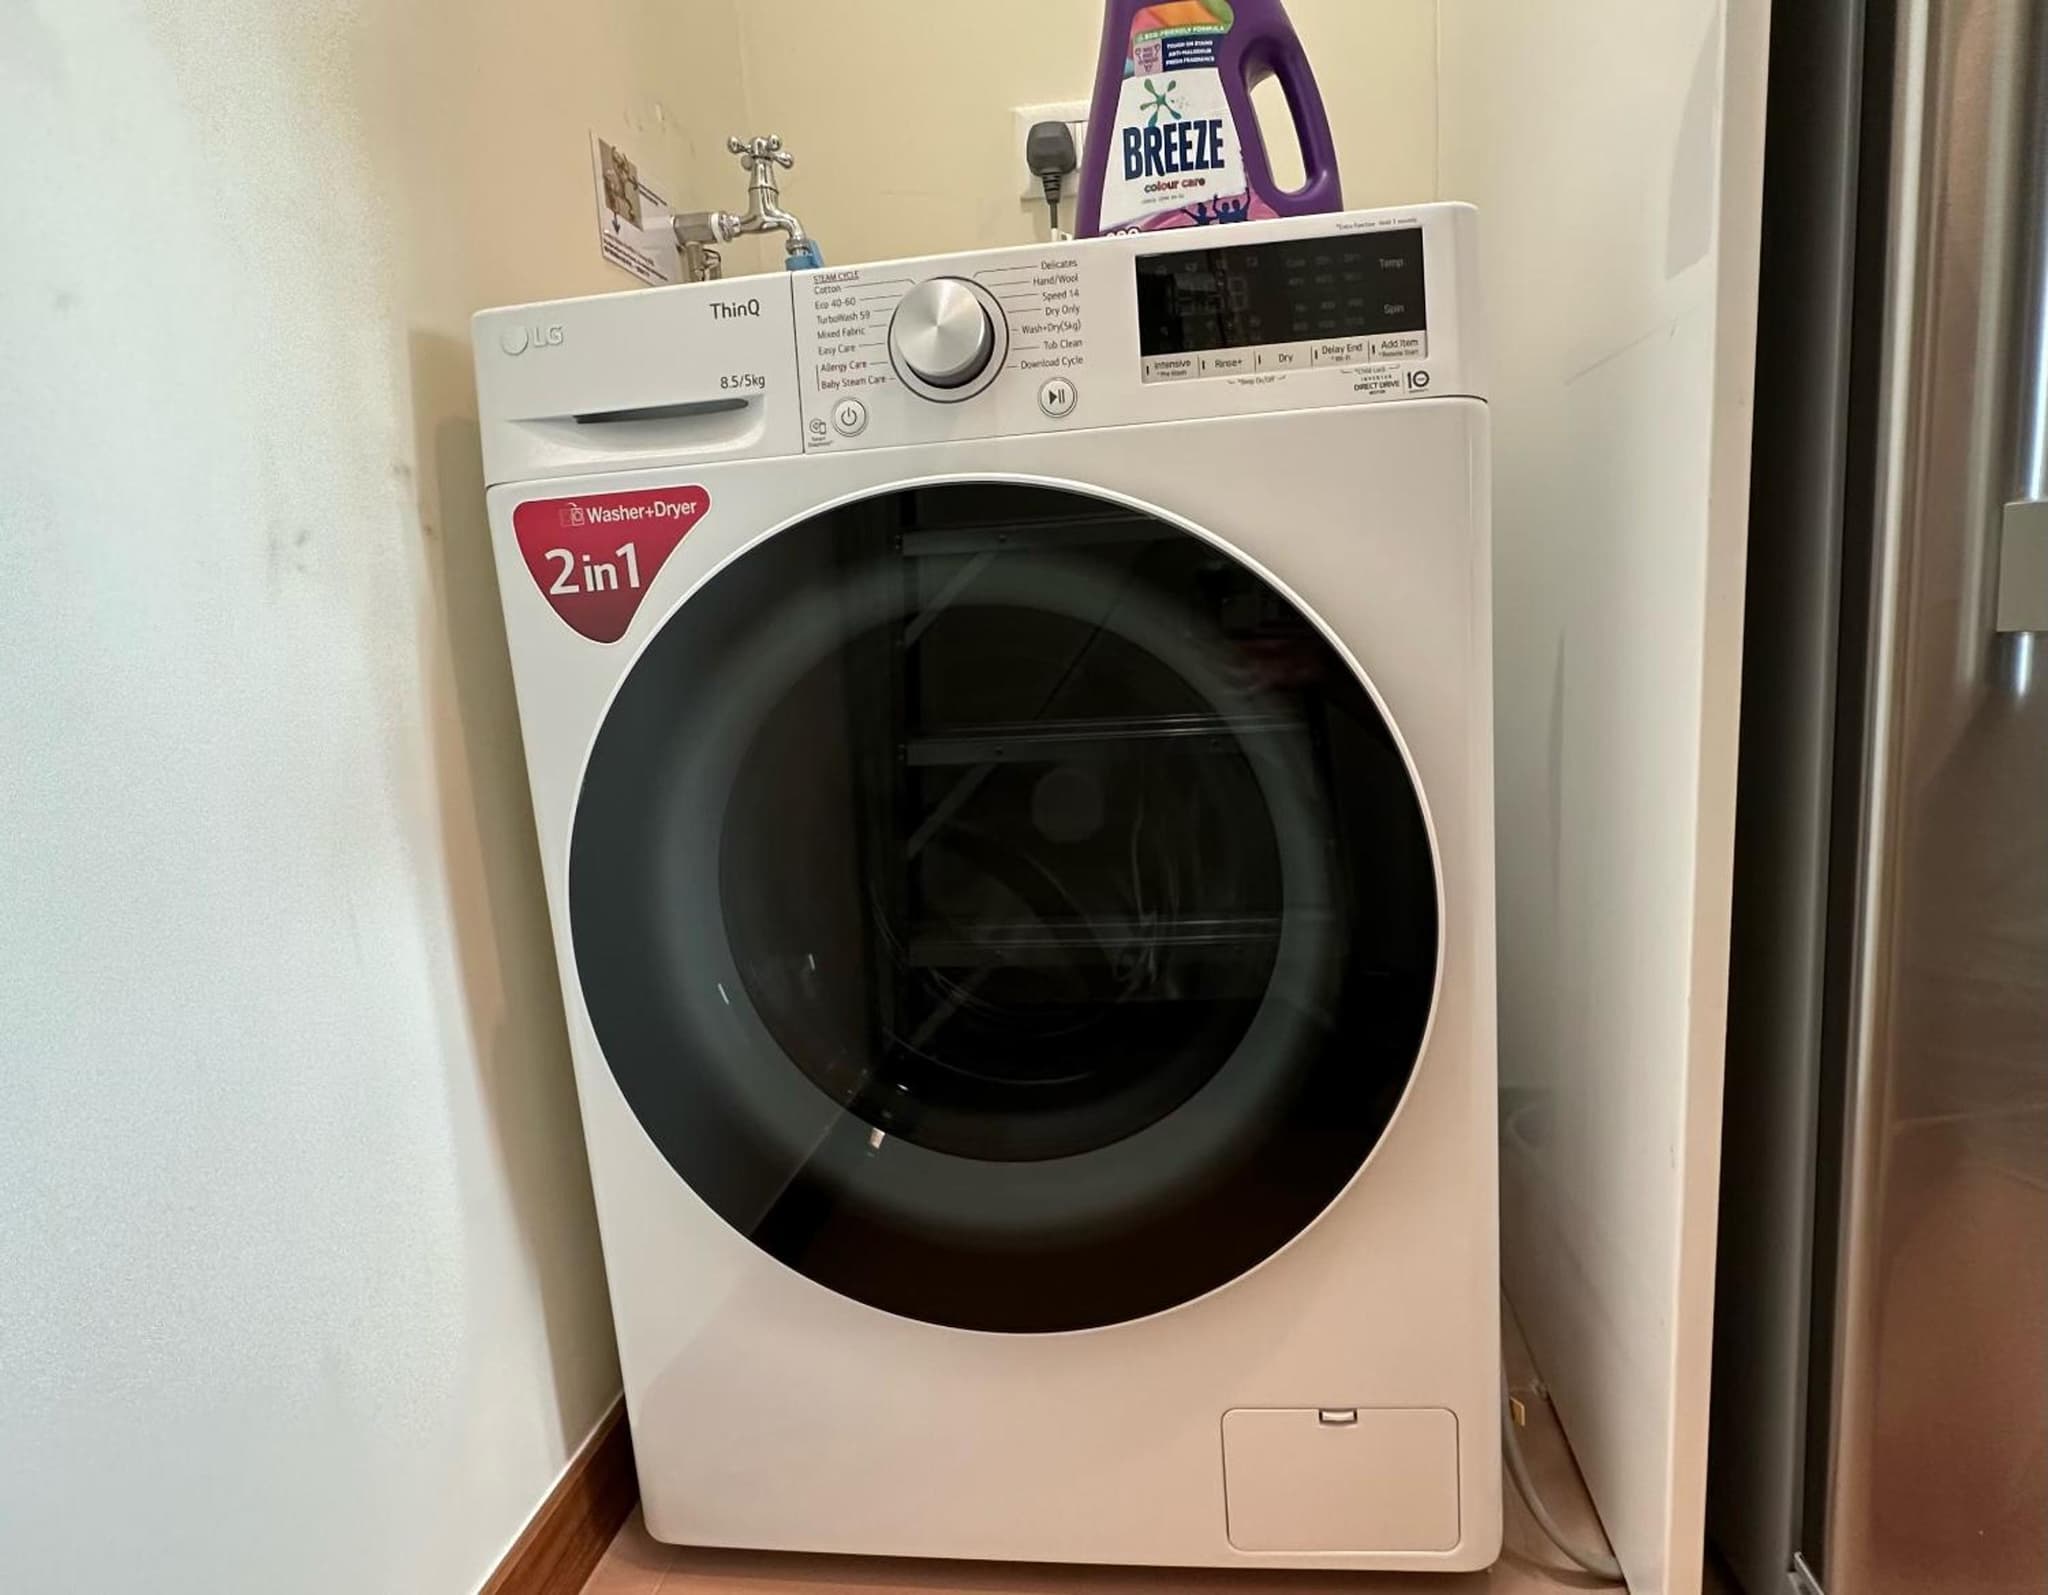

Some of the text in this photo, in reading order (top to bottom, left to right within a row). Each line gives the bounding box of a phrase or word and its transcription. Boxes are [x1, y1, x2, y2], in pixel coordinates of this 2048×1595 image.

[1122, 119, 1225, 181] BREEZE
[1144, 178, 1206, 193] colour care
[1040, 260, 1078, 270] Delicates
[813, 271, 860, 284] STEAM CYCLE
[1033, 273, 1079, 286] Hand/Wool
[814, 286, 842, 295] Cotton
[1042, 289, 1080, 302] Speed 14
[710, 298, 760, 320] ThinQ
[815, 297, 856, 310] Eco 40-60
[1383, 303, 1405, 315] Spin
[1045, 304, 1081, 317] Dry Only
[816, 312, 858, 325] TurboWash
[533, 325, 564, 347] LG
[817, 326, 866, 339] Mixed Fabric
[818, 344, 856, 356] Easy Care
[1043, 338, 1083, 350] Tub Clean
[1321, 342, 1363, 355] Delay End
[1381, 339, 1419, 349] Add Item
[1020, 355, 1084, 370] Download Cycle
[1154, 359, 1191, 370] Intensive
[1278, 353, 1293, 363] Dry
[820, 361, 867, 373] Allergy Care
[720, 374, 766, 390] 8.5/5kg
[821, 375, 886, 390] Baby Steam Care
[1353, 380, 1400, 391] DIRECT DRIVE
[586, 501, 697, 524] Washer+Dryer
